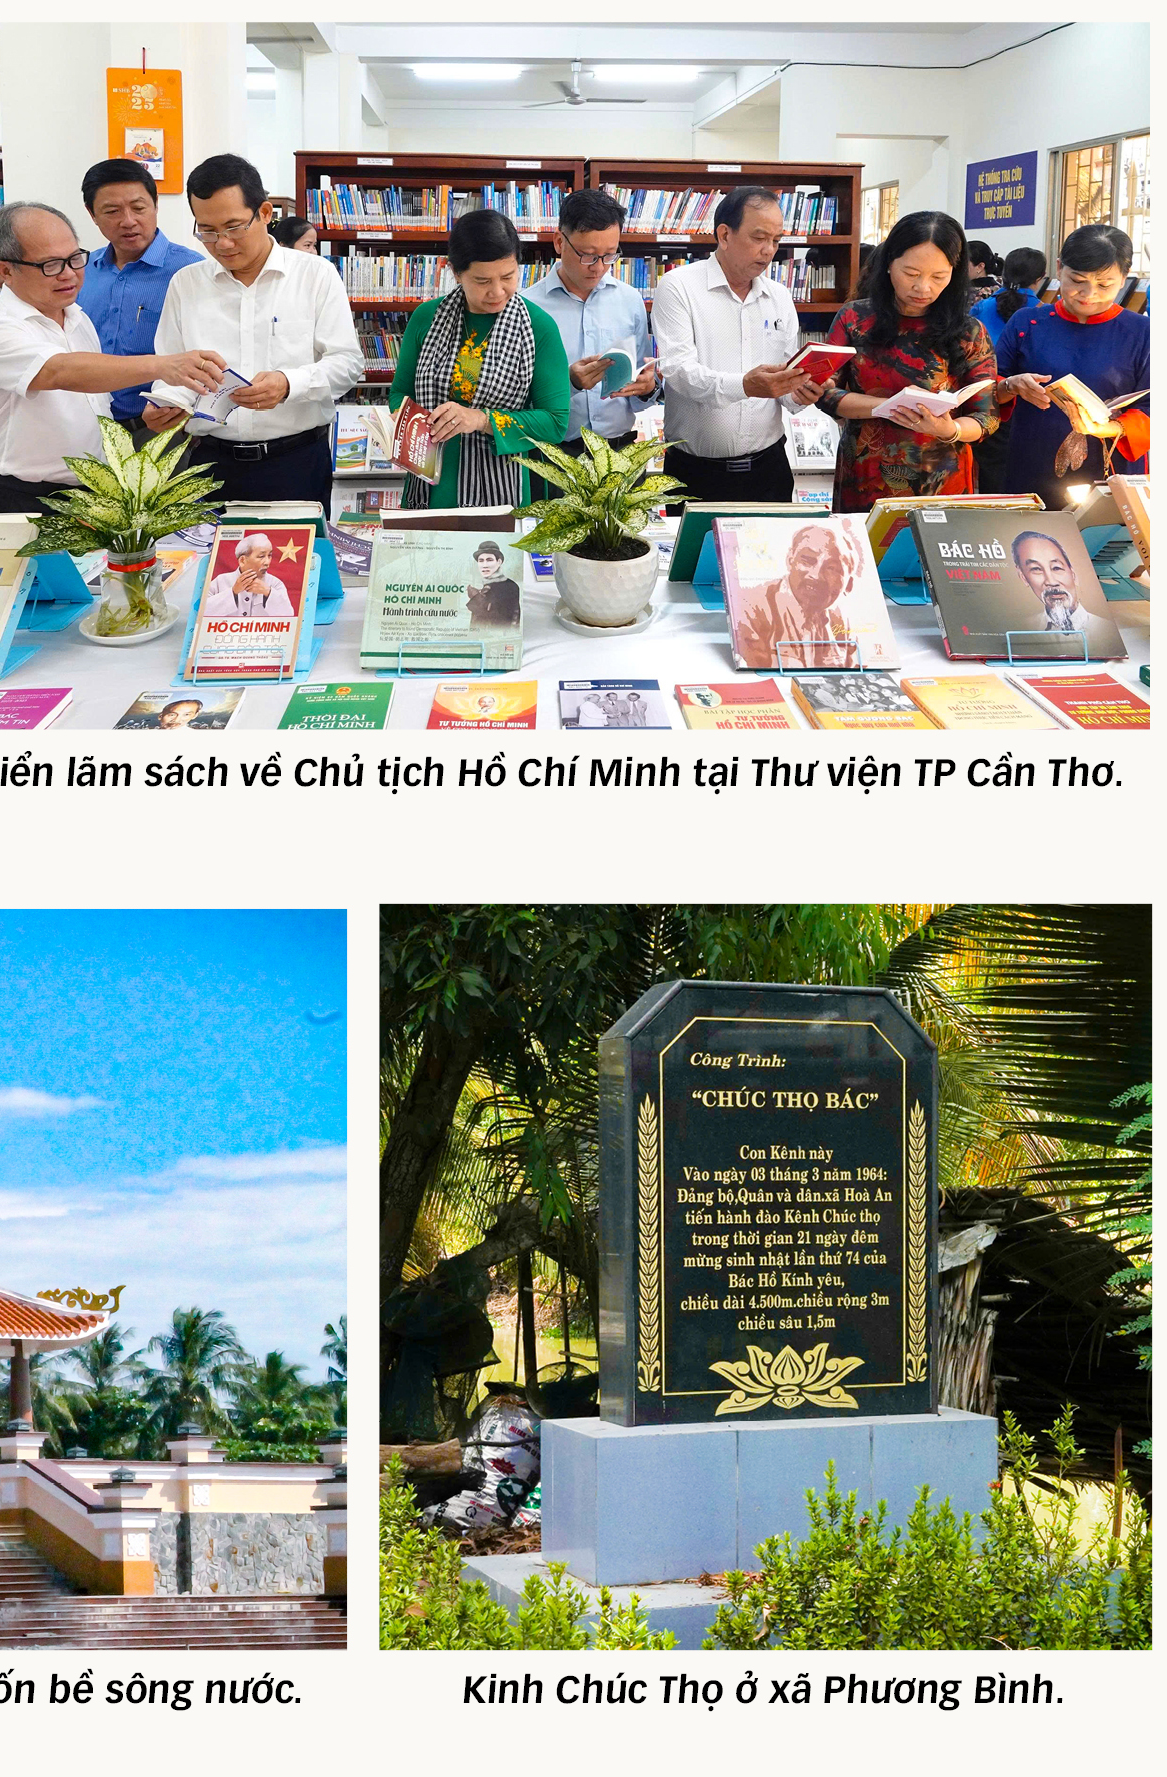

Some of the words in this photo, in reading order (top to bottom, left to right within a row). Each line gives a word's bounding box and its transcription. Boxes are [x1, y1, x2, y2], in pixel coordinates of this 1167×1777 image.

[938, 540, 974, 558] BÁC
[979, 538, 1006, 558] HỒ
[946, 568, 970, 582] VIỆT
[974, 571, 1001, 580] NAM
[207, 620, 228, 632] HỒ
[230, 620, 254, 632] CHÍ
[255, 622, 290, 632] MINH
[690, 1052, 733, 1069] Công
[738, 1053, 786, 1067] Trình:
[692, 1086, 766, 1107] “CHÚC
[773, 1092, 819, 1112] THỌ
[826, 1088, 879, 1109] BÁC”
[740, 1145, 766, 1159] Con
[770, 1146, 806, 1159] Kênh
[809, 1147, 833, 1163] này
[683, 1167, 710, 1181] Vào
[714, 1167, 747, 1183] ngày
[751, 1167, 766, 1181] 03
[770, 1167, 808, 1184] tháng
[812, 1167, 819, 1181] 3
[823, 1168, 852, 1181] năm
[856, 1167, 887, 1181] 1964:
[677, 1188, 714, 1206] Đảng
[777, 1189, 792, 1202] và
[844, 1188, 870, 1202] Hoà
[874, 1188, 892, 1202] An
[686, 1208, 713, 1224] tiến
[717, 1210, 751, 1224] hành
[756, 1210, 780, 1224] đào
[784, 1209, 820, 1224] Kênh
[823, 1209, 856, 1223] Chúc
[860, 1210, 881, 1226] thọ
[692, 1233, 729, 1248] trong
[733, 1231, 760, 1245] thời
[765, 1232, 793, 1248] gian
[797, 1231, 810, 1244] 21
[816, 1232, 847, 1247] ngày
[852, 1231, 879, 1244] đêm
[684, 1253, 722, 1270] mừng
[726, 1253, 755, 1267] sinh
[759, 1252, 790, 1268] nhật
[794, 1249, 815, 1265] lần
[819, 1251, 842, 1265] thứ
[846, 1251, 860, 1264] 74
[864, 1250, 887, 1265] của
[728, 1273, 754, 1288] Bác
[758, 1272, 777, 1287] Hồ
[782, 1273, 813, 1287] Kính
[817, 1273, 845, 1289] yêu,
[681, 1293, 718, 1310] chiều
[723, 1295, 744, 1309] dài
[837, 1294, 867, 1309] rộng
[871, 1293, 889, 1306] 3m
[738, 1314, 775, 1330] chiều
[779, 1316, 802, 1329] sâu
[807, 1315, 836, 1331] 1,5m
